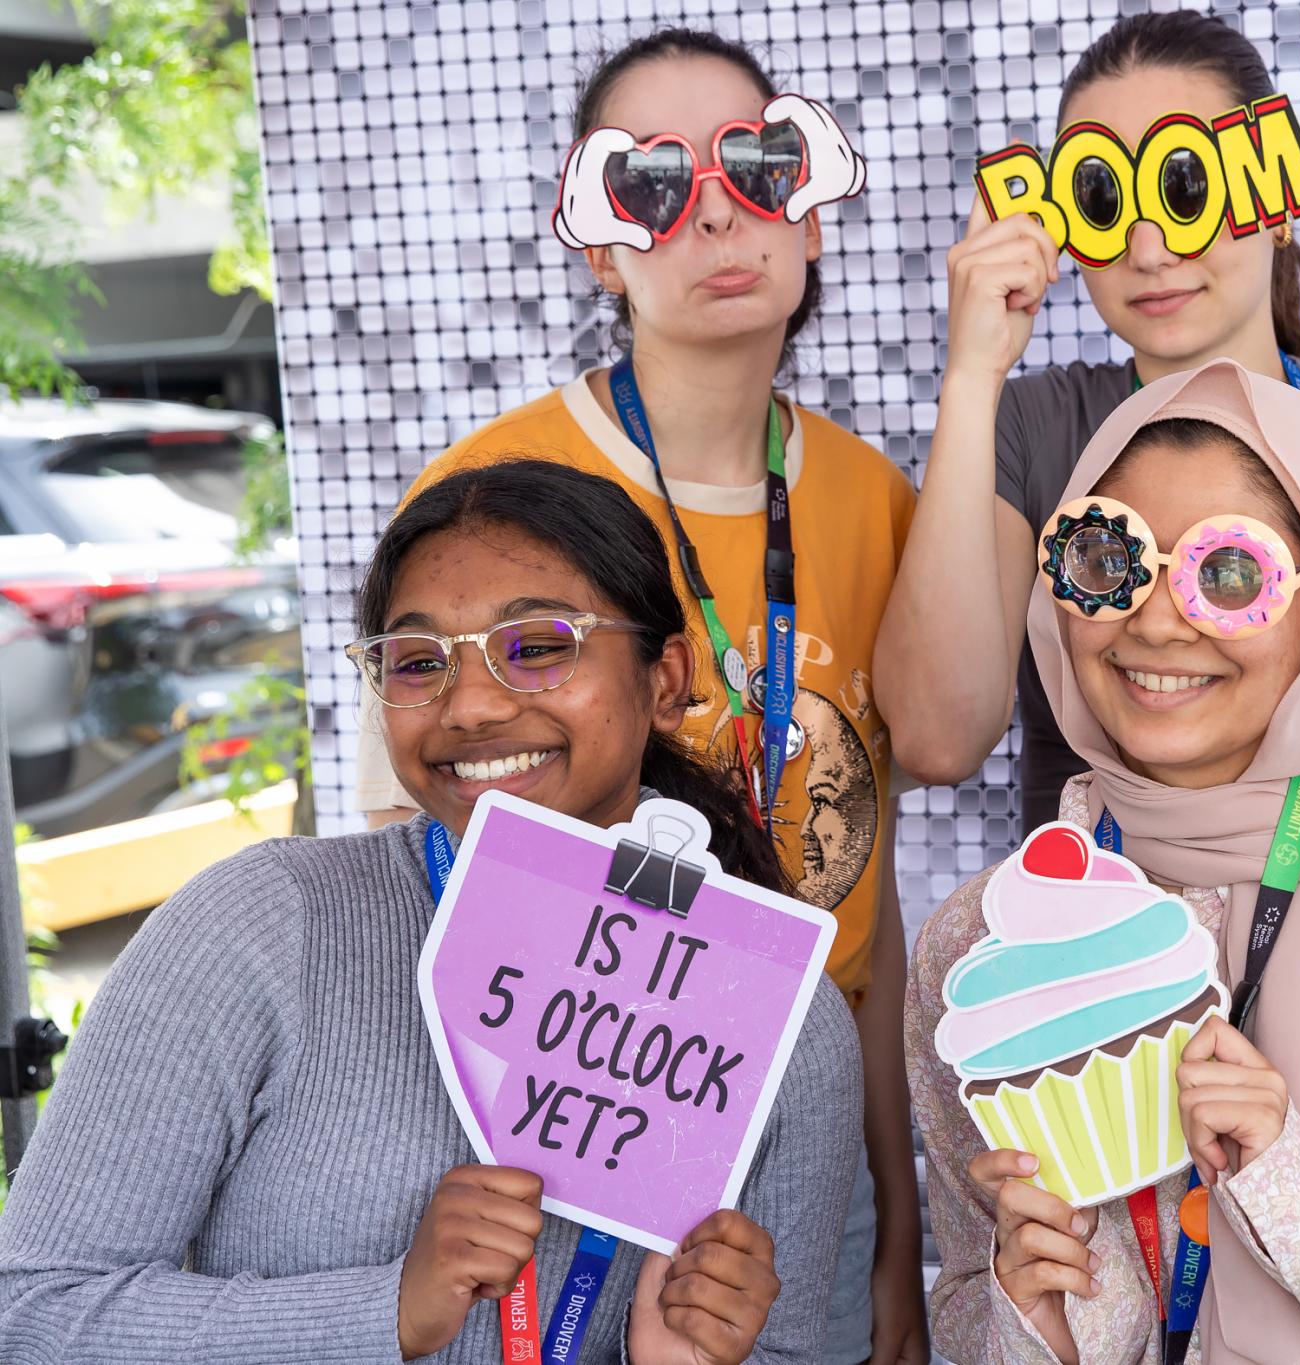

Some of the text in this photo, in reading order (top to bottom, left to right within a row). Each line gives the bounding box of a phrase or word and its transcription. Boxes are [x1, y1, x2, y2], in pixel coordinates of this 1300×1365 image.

[775, 632, 787, 687] NCLUSIVITY
[575, 904, 709, 1000] IS IT
[479, 965, 744, 1113] 5 O'CLOCK
[511, 1074, 648, 1170] YET?
[1181, 1240, 1203, 1287] COVERY
[551, 1294, 587, 1362] DISCOVERY
